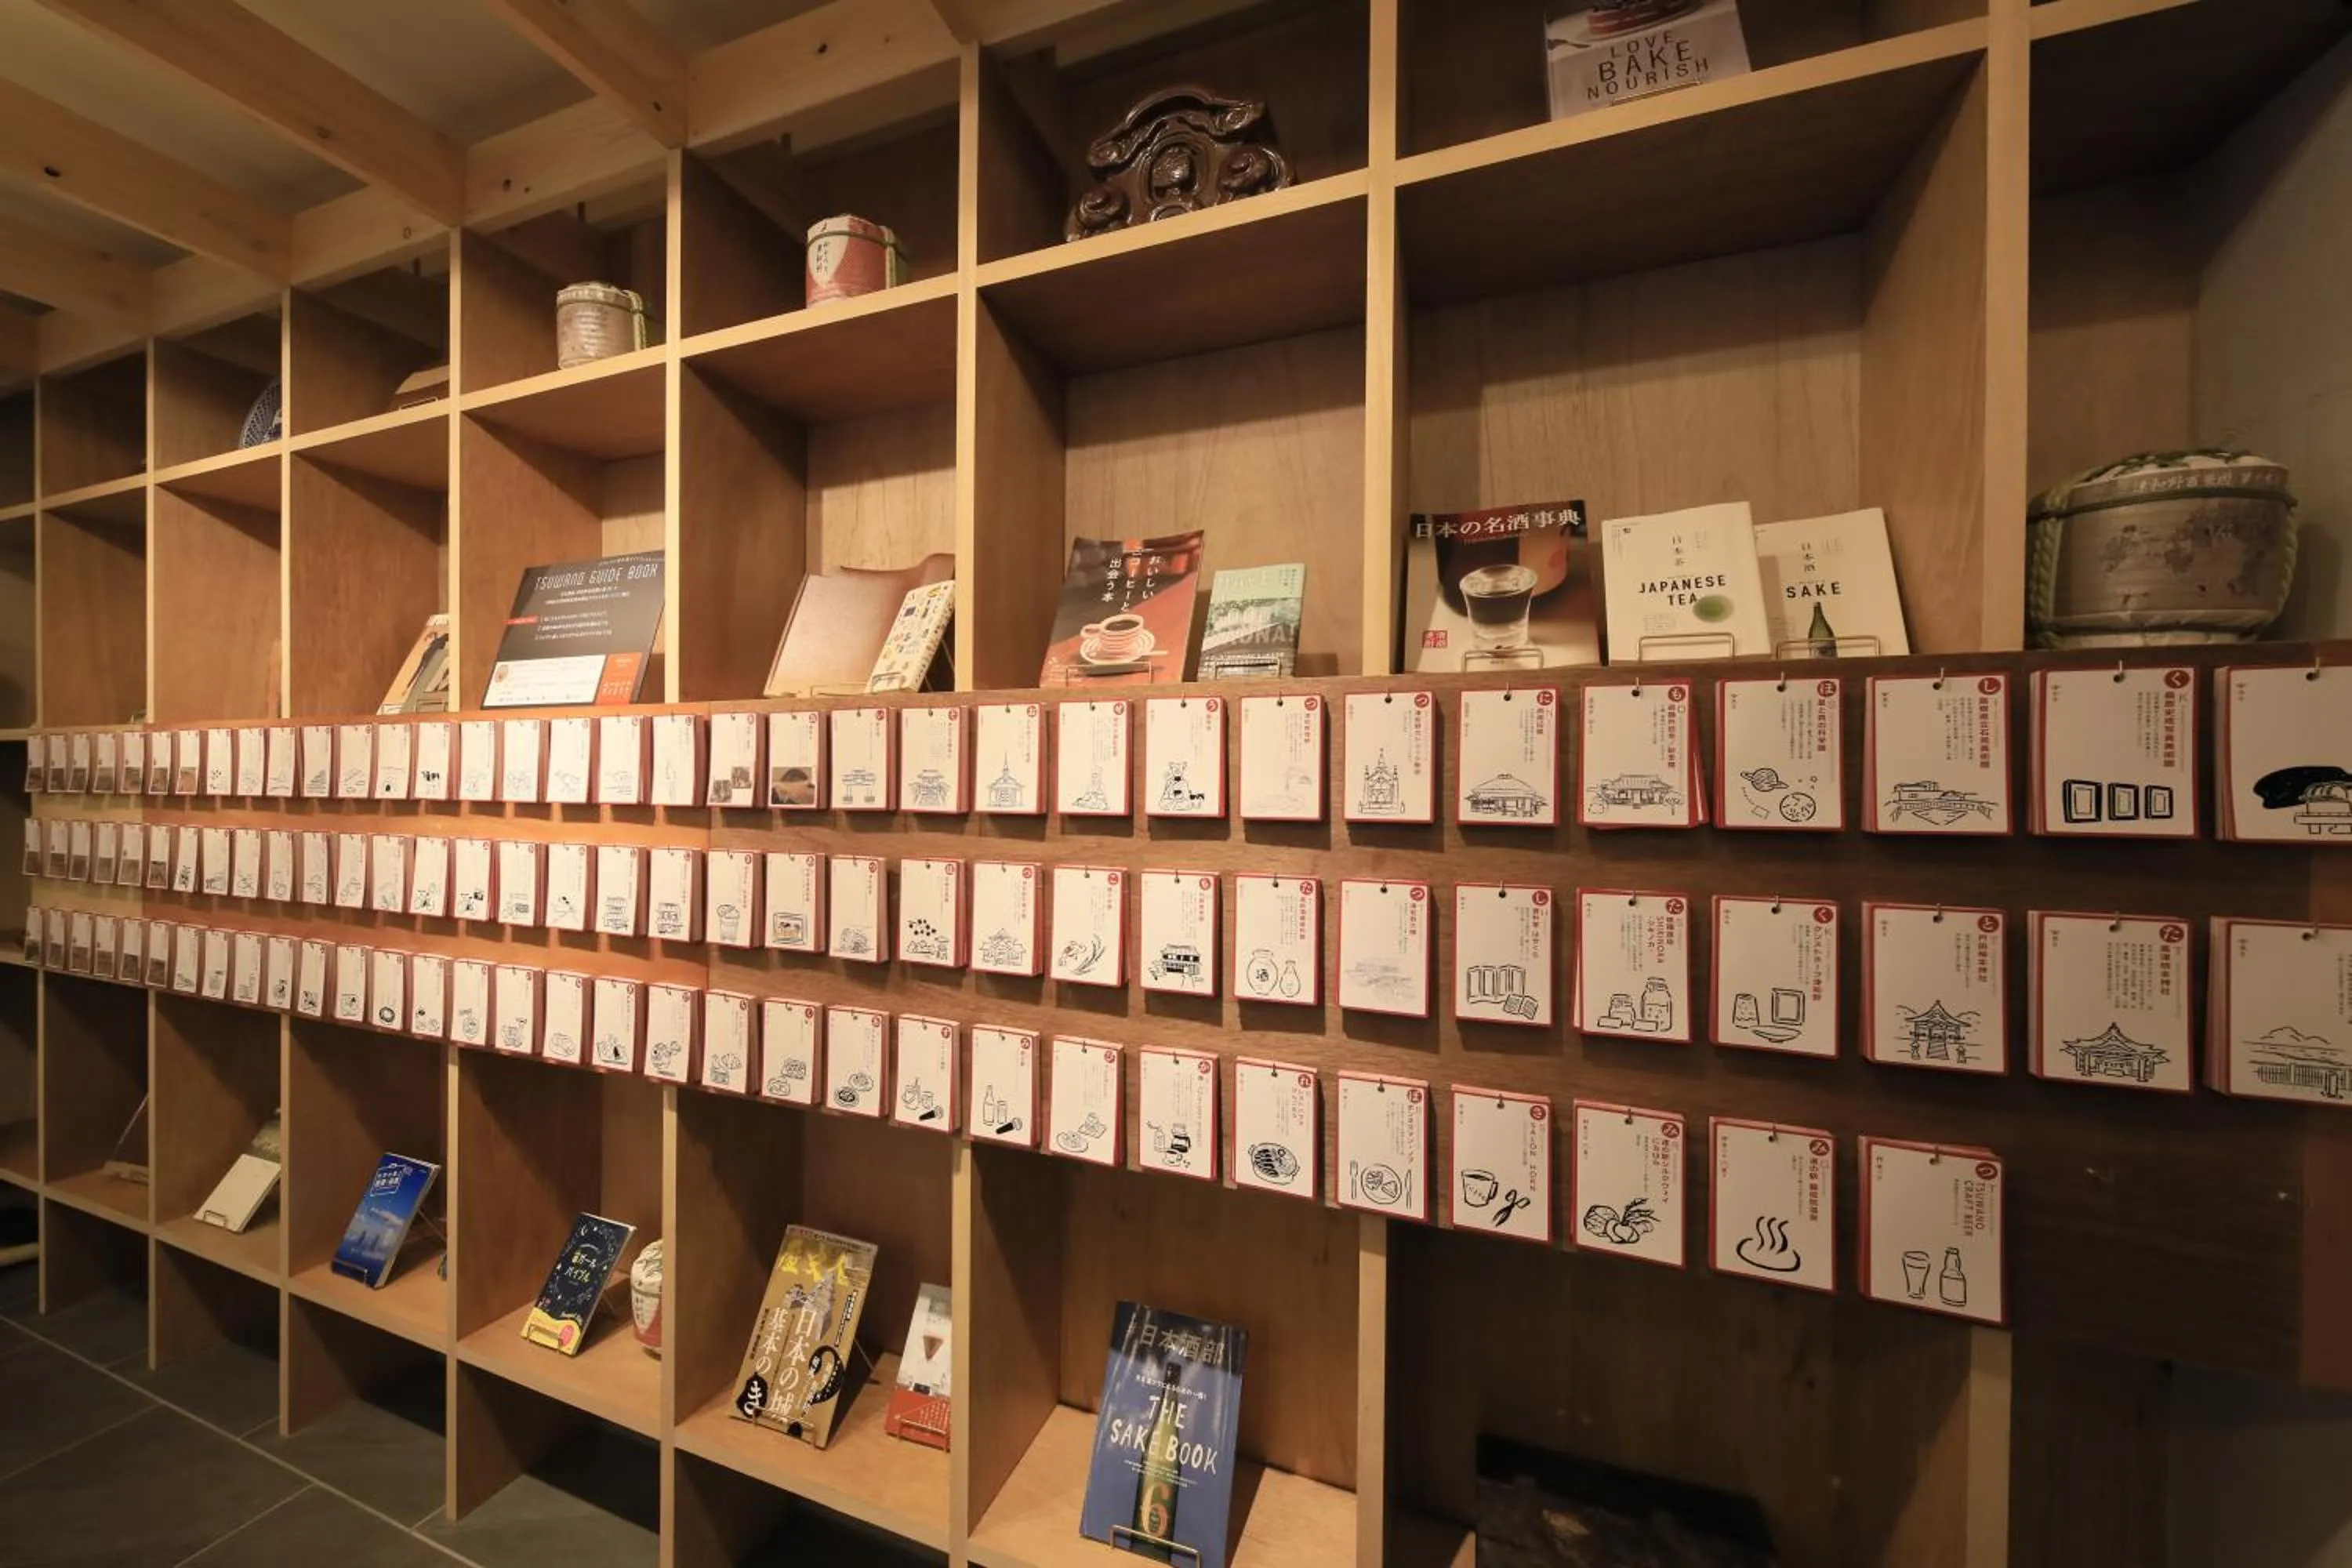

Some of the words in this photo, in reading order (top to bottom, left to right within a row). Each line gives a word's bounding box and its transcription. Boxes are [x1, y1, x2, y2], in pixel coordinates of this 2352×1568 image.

[1610, 30, 1675, 59] LOVE
[1599, 39, 1693, 82] BAKE
[1587, 57, 1709, 100] NOURISH
[1414, 508, 1581, 539] 日本の名酒事典
[1639, 574, 1727, 594] JAPANESE
[1786, 581, 1842, 599] SAKE
[1666, 593, 1700, 607] TEA
[1148, 1395, 1189, 1429] THE
[1109, 1418, 1162, 1457] SAKE
[1165, 1438, 1218, 1475] BOOK
